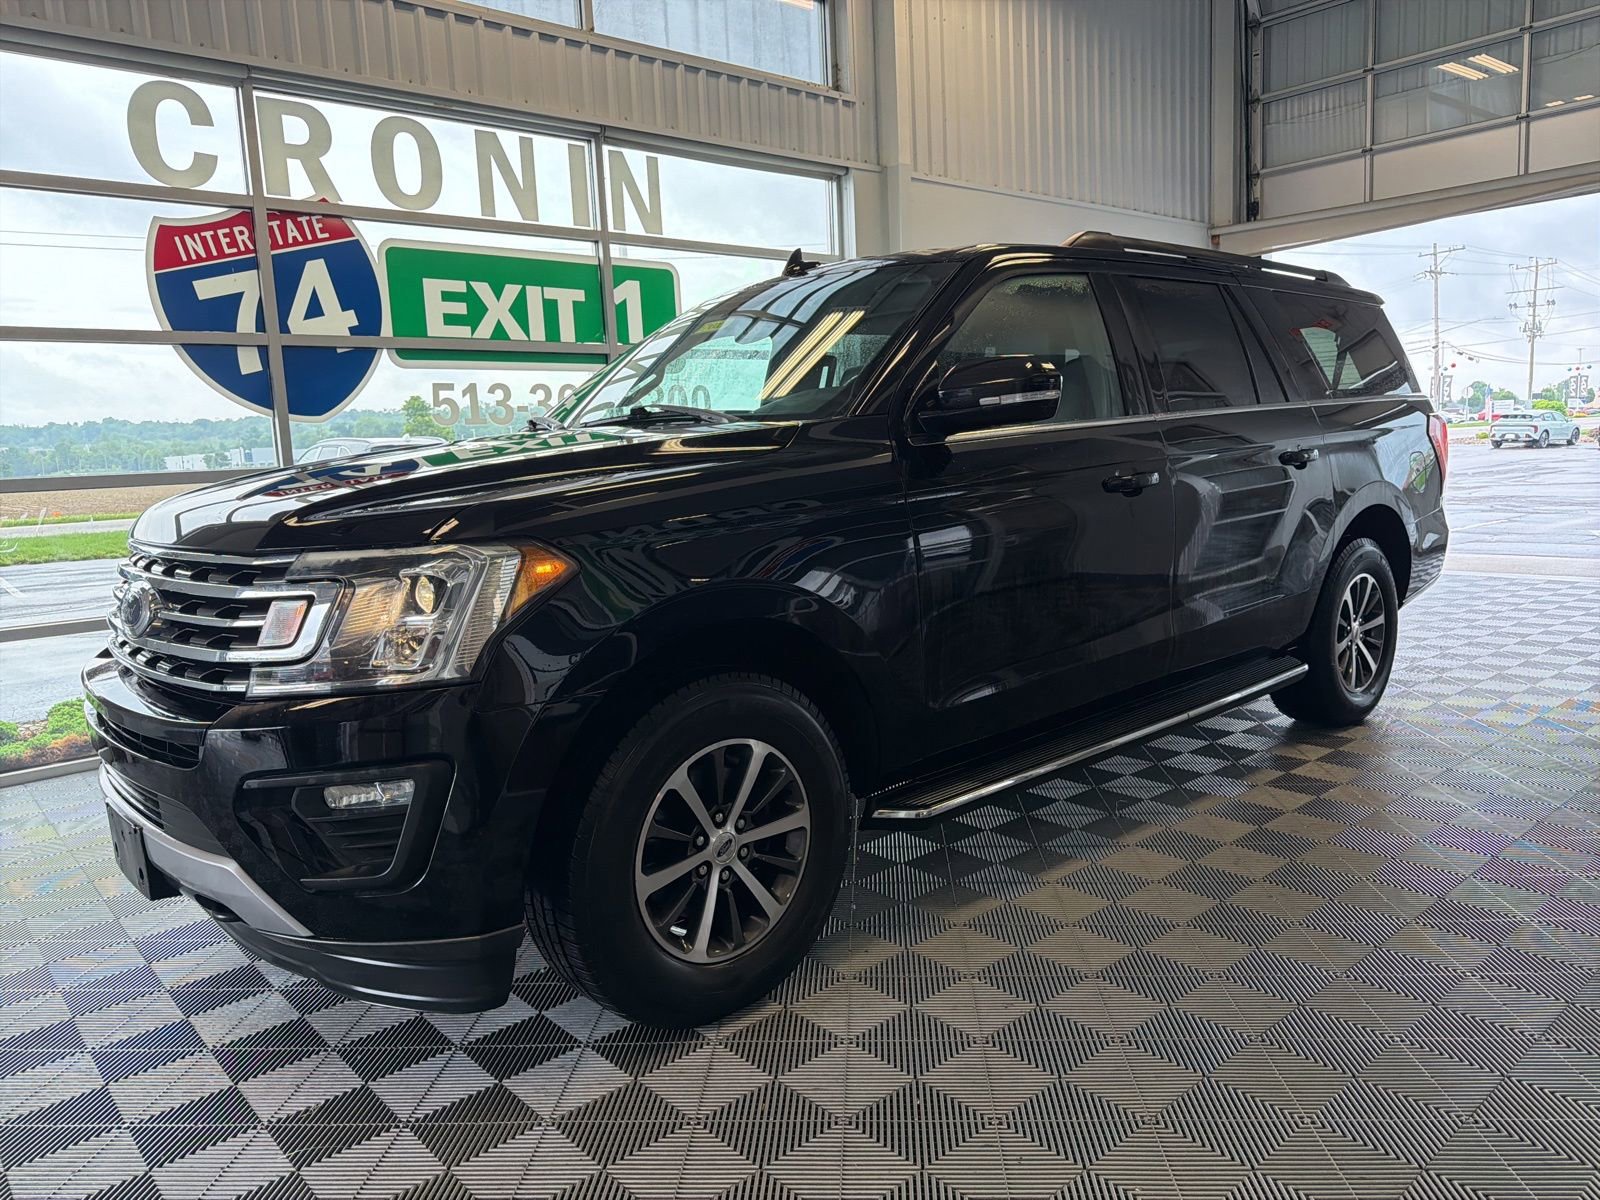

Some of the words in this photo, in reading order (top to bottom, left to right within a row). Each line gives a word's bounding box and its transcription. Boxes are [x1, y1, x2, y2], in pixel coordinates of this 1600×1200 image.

[127, 81, 663, 235] CRONIN
[174, 213, 330, 262] INTERTATE
[192, 258, 359, 376] 74
[422, 278, 586, 343] EXIT
[613, 280, 644, 344] 1
